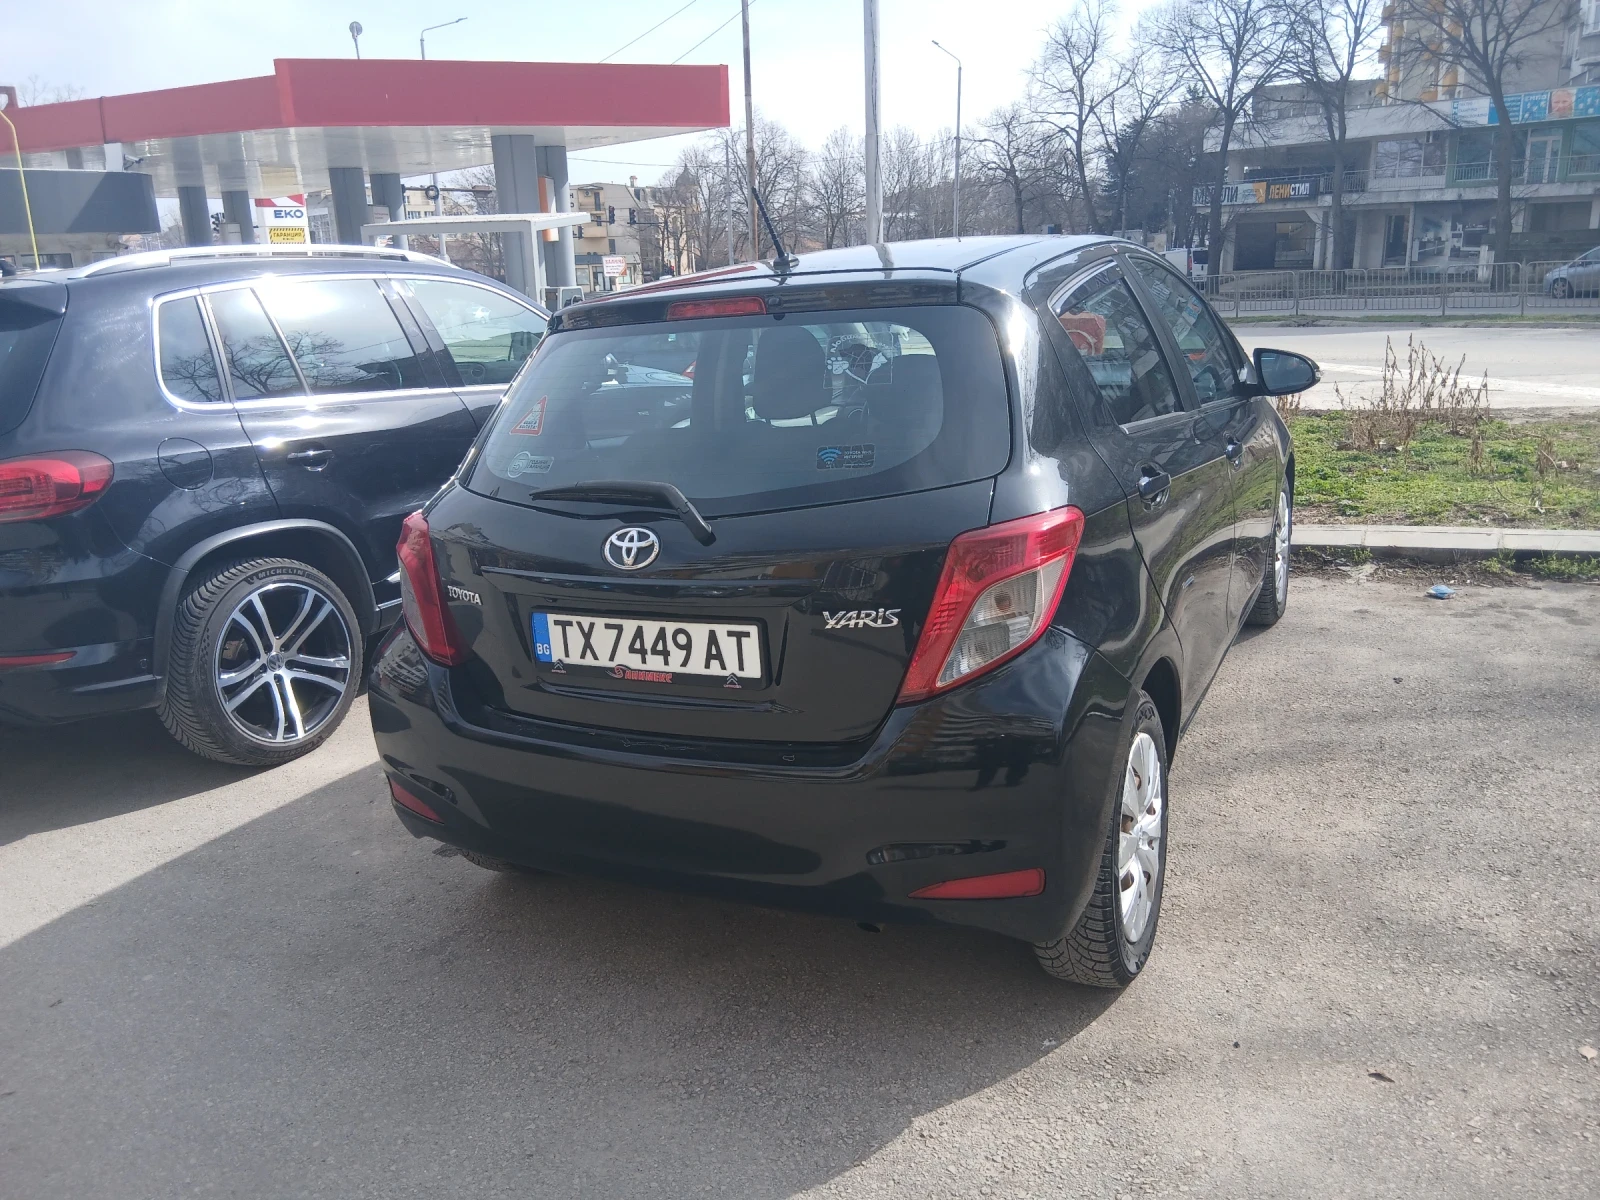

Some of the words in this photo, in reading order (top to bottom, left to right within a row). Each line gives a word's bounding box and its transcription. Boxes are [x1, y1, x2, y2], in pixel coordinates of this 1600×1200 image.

[273, 209, 304, 219] EKO
[258, 568, 304, 579] MICHELIN
[447, 585, 482, 606] TOYOTA
[536, 643, 550, 656] BG
